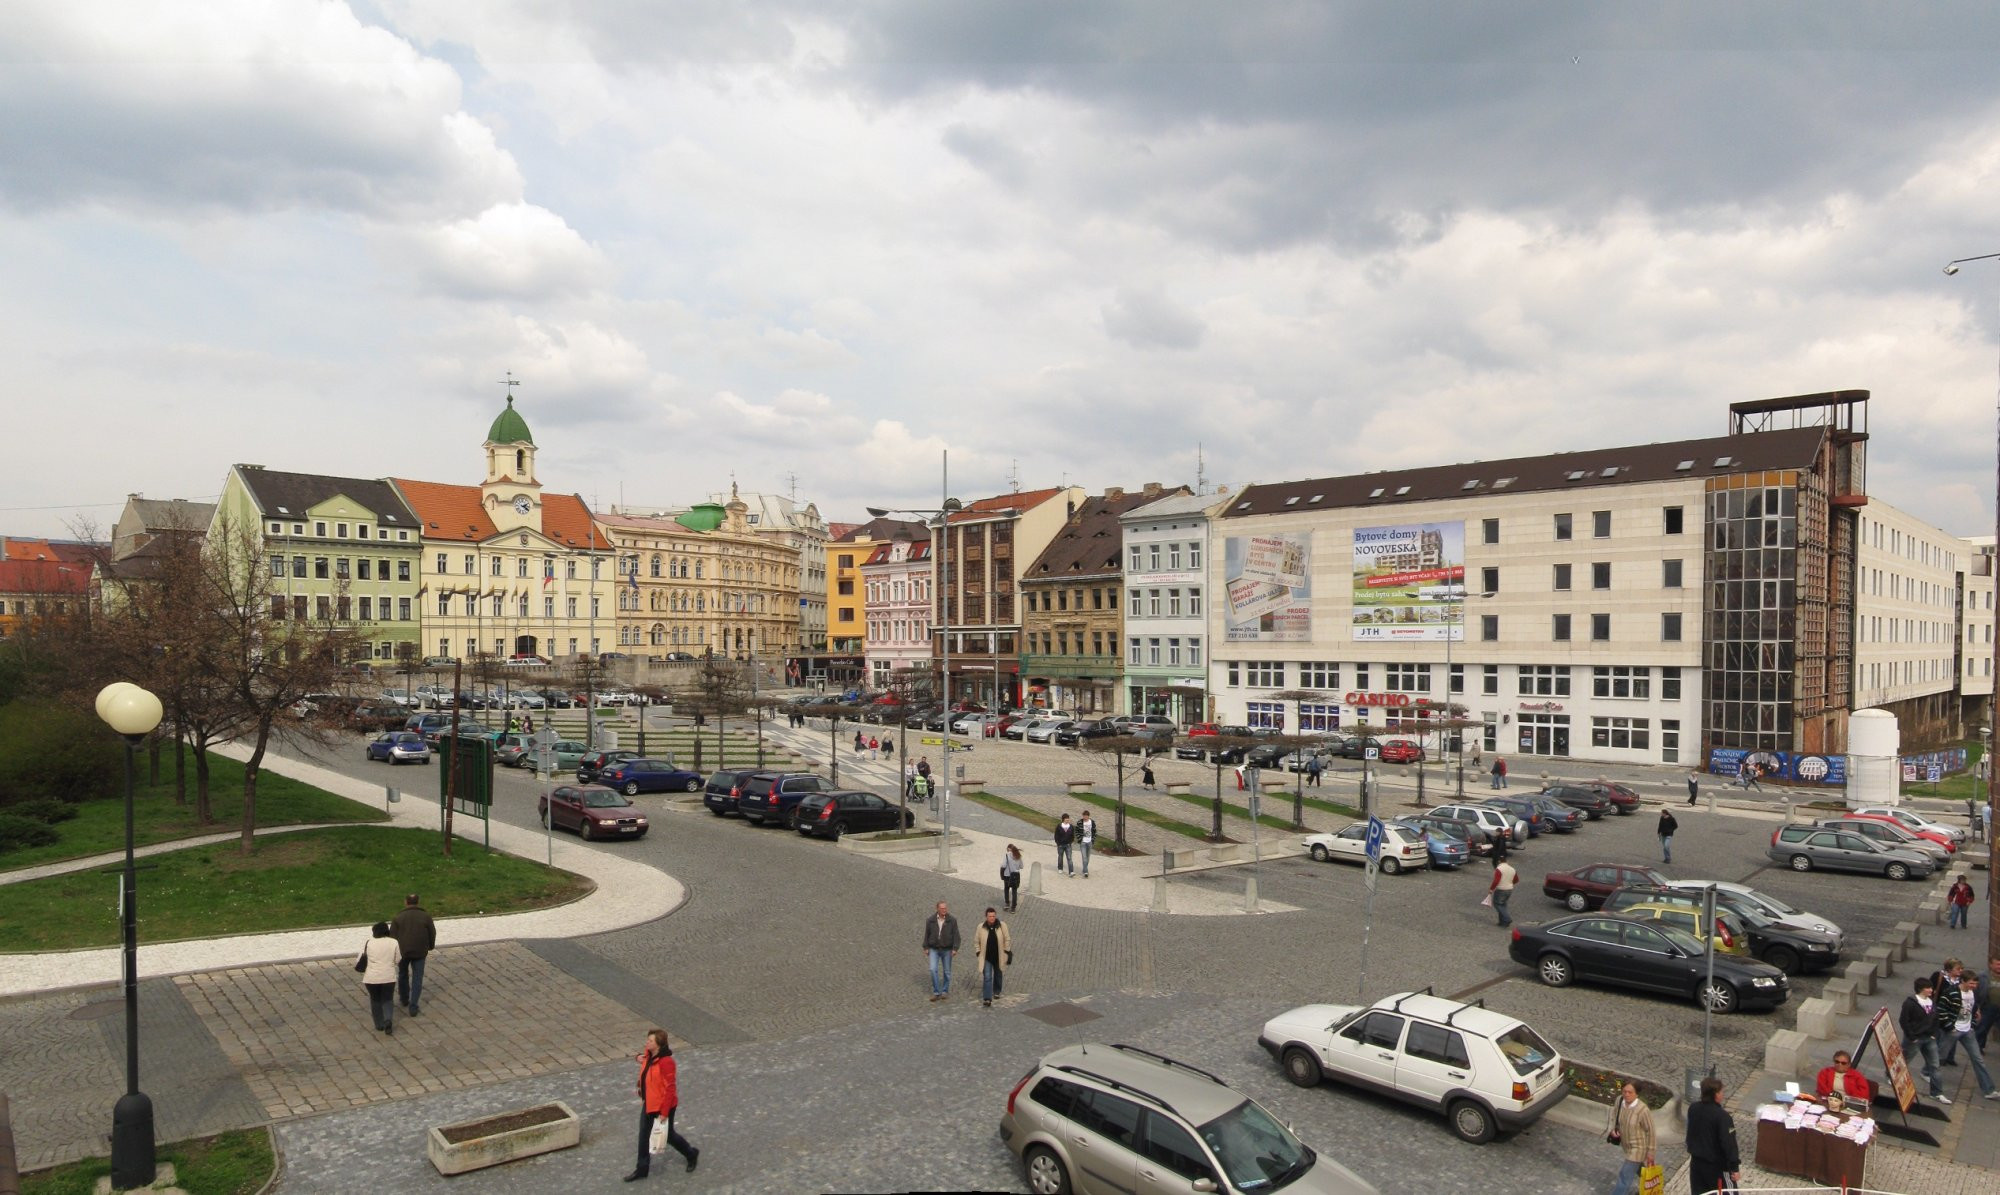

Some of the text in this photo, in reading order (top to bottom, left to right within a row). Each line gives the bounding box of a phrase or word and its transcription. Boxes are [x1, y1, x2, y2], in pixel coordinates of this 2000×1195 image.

[1355, 529, 1417, 543] Bytové domy
[1355, 541, 1417, 555] NOVOVESKÁ
[1345, 692, 1410, 707] CASINO
[1369, 821, 1379, 844] P
